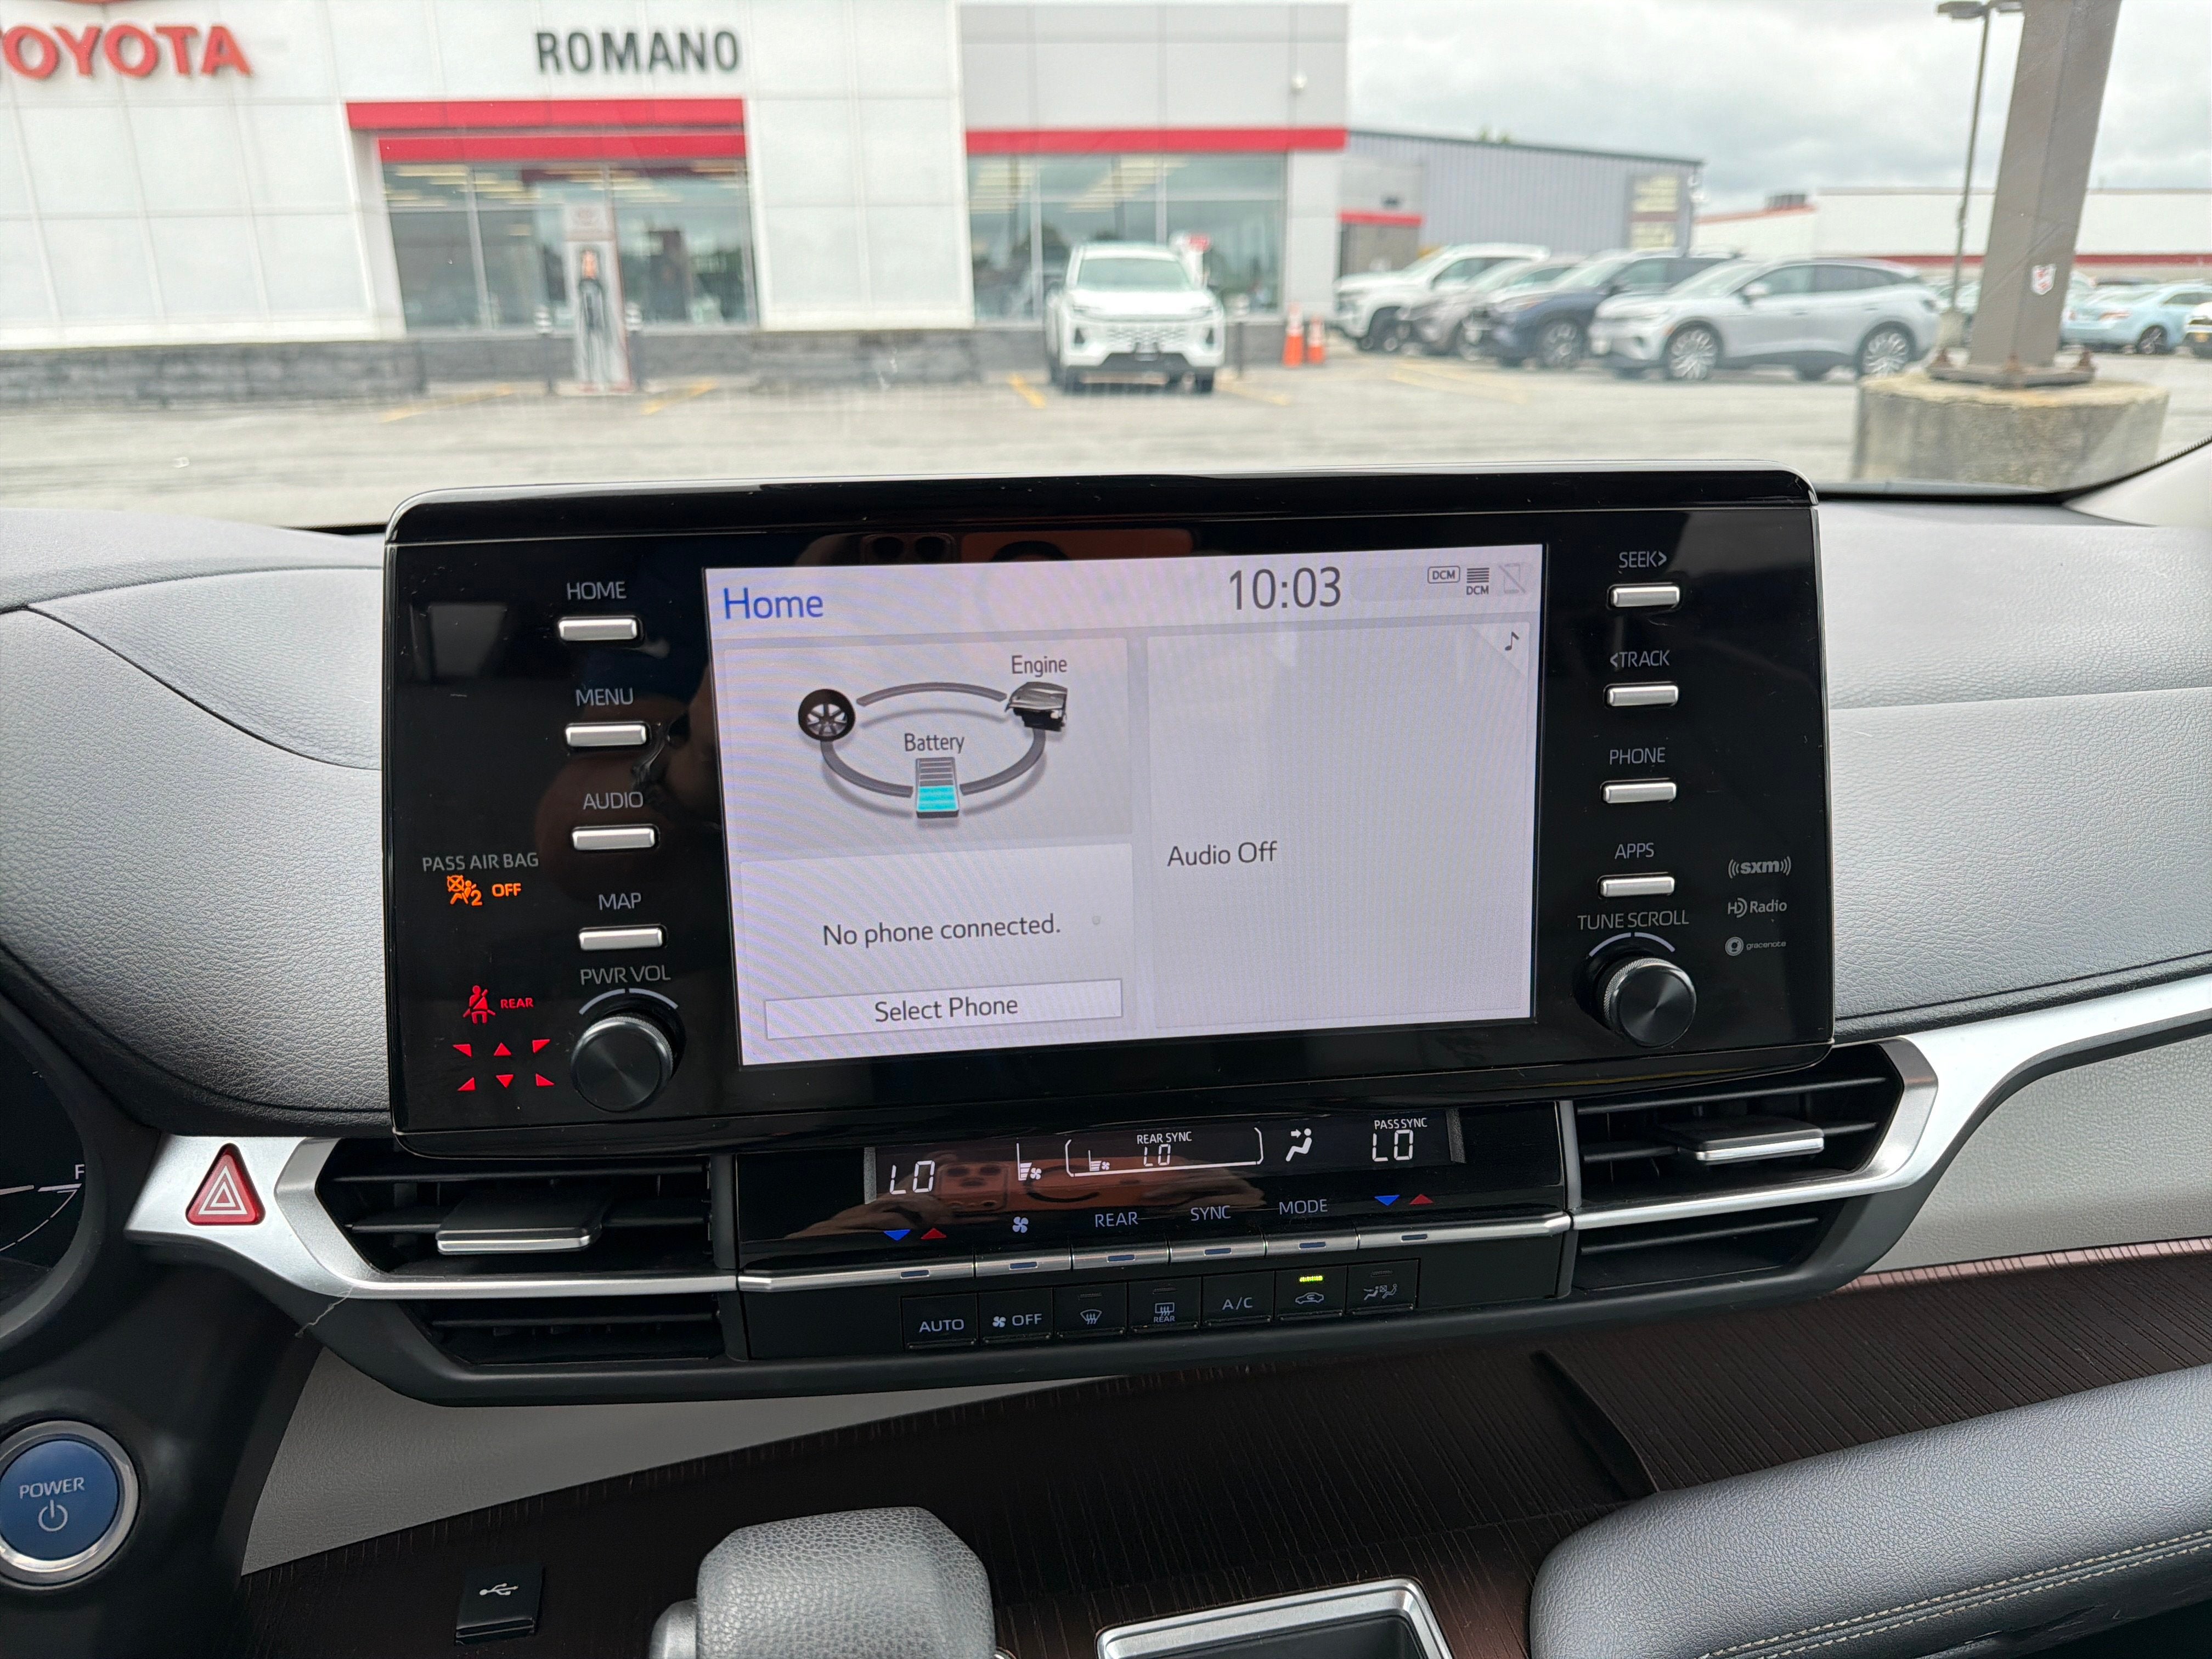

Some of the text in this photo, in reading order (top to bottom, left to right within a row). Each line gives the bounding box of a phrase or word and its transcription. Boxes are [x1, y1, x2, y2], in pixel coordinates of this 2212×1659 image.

[0, 24, 253, 80] OYOTA
[535, 29, 741, 74] ROMANO
[1432, 569, 1455, 580] DCM
[567, 581, 627, 600] HOME
[1230, 566, 1341, 610] 10:03
[1466, 585, 1489, 595] DCM
[723, 587, 823, 619] Home
[1012, 654, 1068, 678] Engine
[575, 688, 634, 706] MENU
[904, 732, 965, 754] Battery
[1610, 747, 1666, 765] PHONE
[583, 792, 644, 810] AUDIO
[1167, 840, 1278, 867] Audio Off
[1614, 842, 1655, 859] APPS
[422, 852, 539, 872] PASS AIR BAG
[492, 883, 522, 897] OFF
[599, 892, 641, 910] MAP
[1750, 899, 1787, 913] Radio
[1577, 910, 1690, 930] TUNE SCROLL
[823, 913, 1060, 949] No phone connected.
[1746, 941, 1786, 951] gracenote
[580, 964, 671, 985] PWR VOL
[500, 997, 534, 1009] REAR
[875, 996, 1018, 1023] Select Phone
[1374, 1118, 1427, 1130] PASS SYNC
[1137, 1131, 1192, 1144] REAR SYNC
[75, 1164, 85, 1180] F
[1190, 1205, 1231, 1221] SYNC
[1279, 1199, 1328, 1215] MODE
[1095, 1211, 1138, 1228] REAR
[1222, 1297, 1253, 1310] A/C
[919, 1319, 964, 1333] AUTO
[1012, 1313, 1042, 1326] OFF
[19, 1476, 85, 1498] POWER
